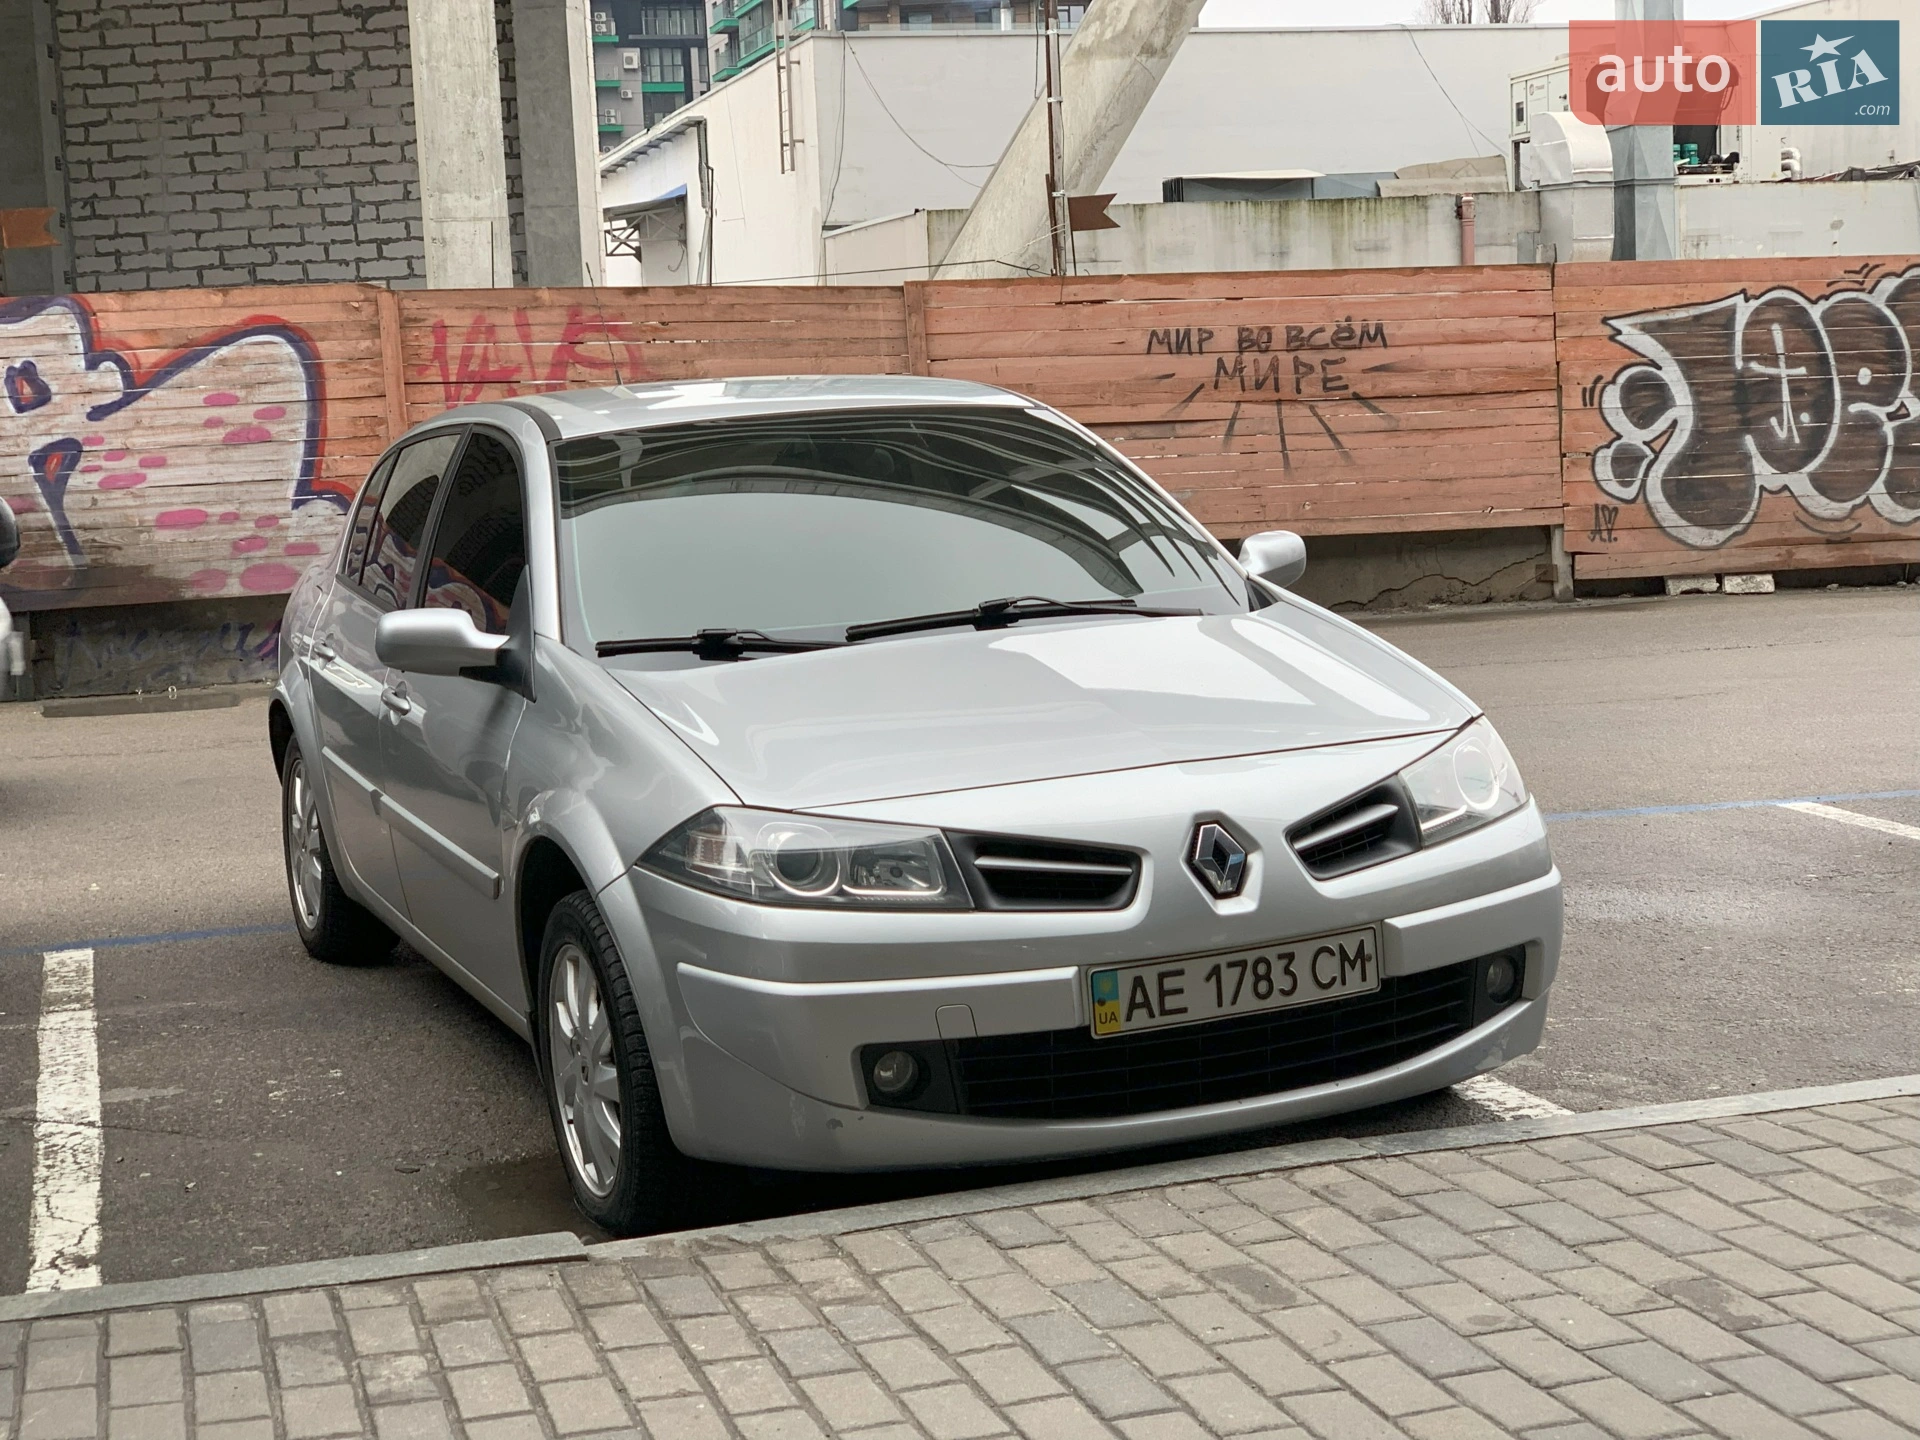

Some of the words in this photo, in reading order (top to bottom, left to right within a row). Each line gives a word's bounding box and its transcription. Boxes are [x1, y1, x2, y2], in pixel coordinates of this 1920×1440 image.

[1146, 327, 1214, 355] МИР
[1237, 325, 1273, 354] ВО
[1213, 354, 1349, 394] МИРЕ
[1125, 968, 1189, 1022] AE
[1204, 951, 1298, 1009] 1783
[1311, 938, 1368, 990] CM
[1098, 1010, 1119, 1026] UA
